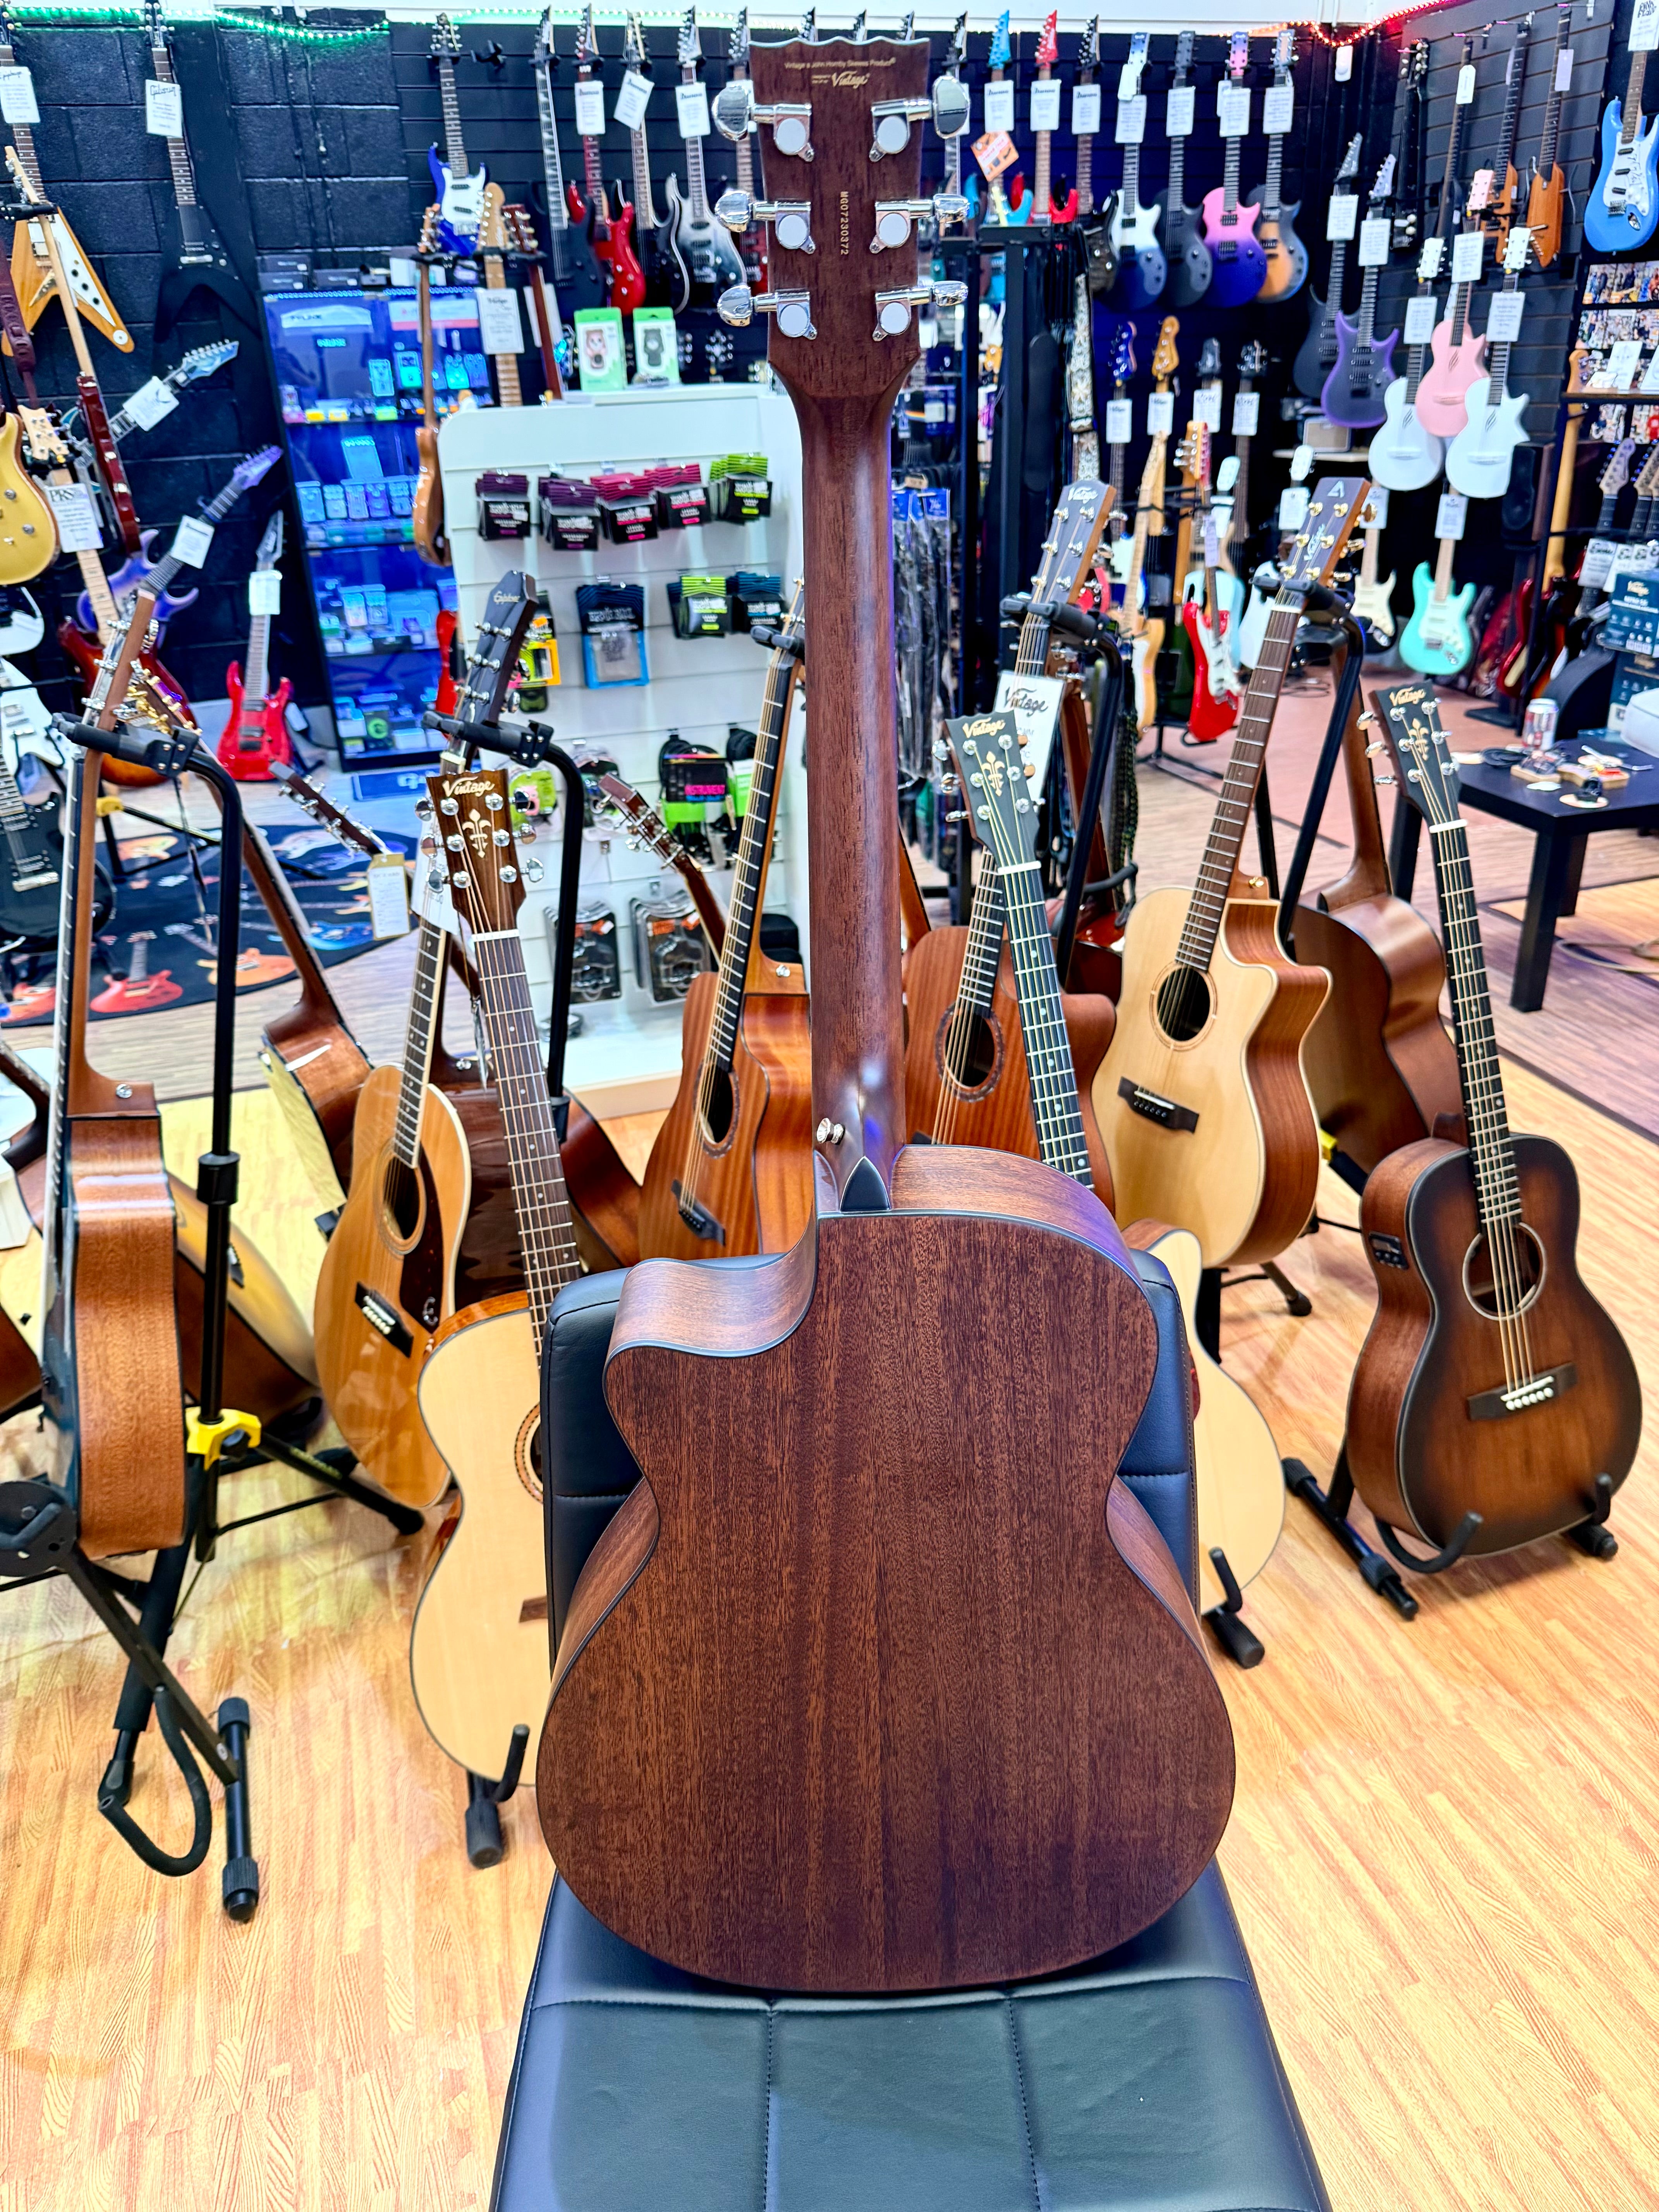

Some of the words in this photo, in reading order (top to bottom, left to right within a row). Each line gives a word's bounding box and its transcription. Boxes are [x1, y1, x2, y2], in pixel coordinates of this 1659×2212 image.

[150, 84, 177, 100] Gibson
[49, 489, 74, 502] PRS
[1004, 686, 1049, 717] Vintage
[1389, 686, 1427, 706] Vintage
[962, 717, 1006, 738] Vintage
[442, 776, 495, 797] Vintage
